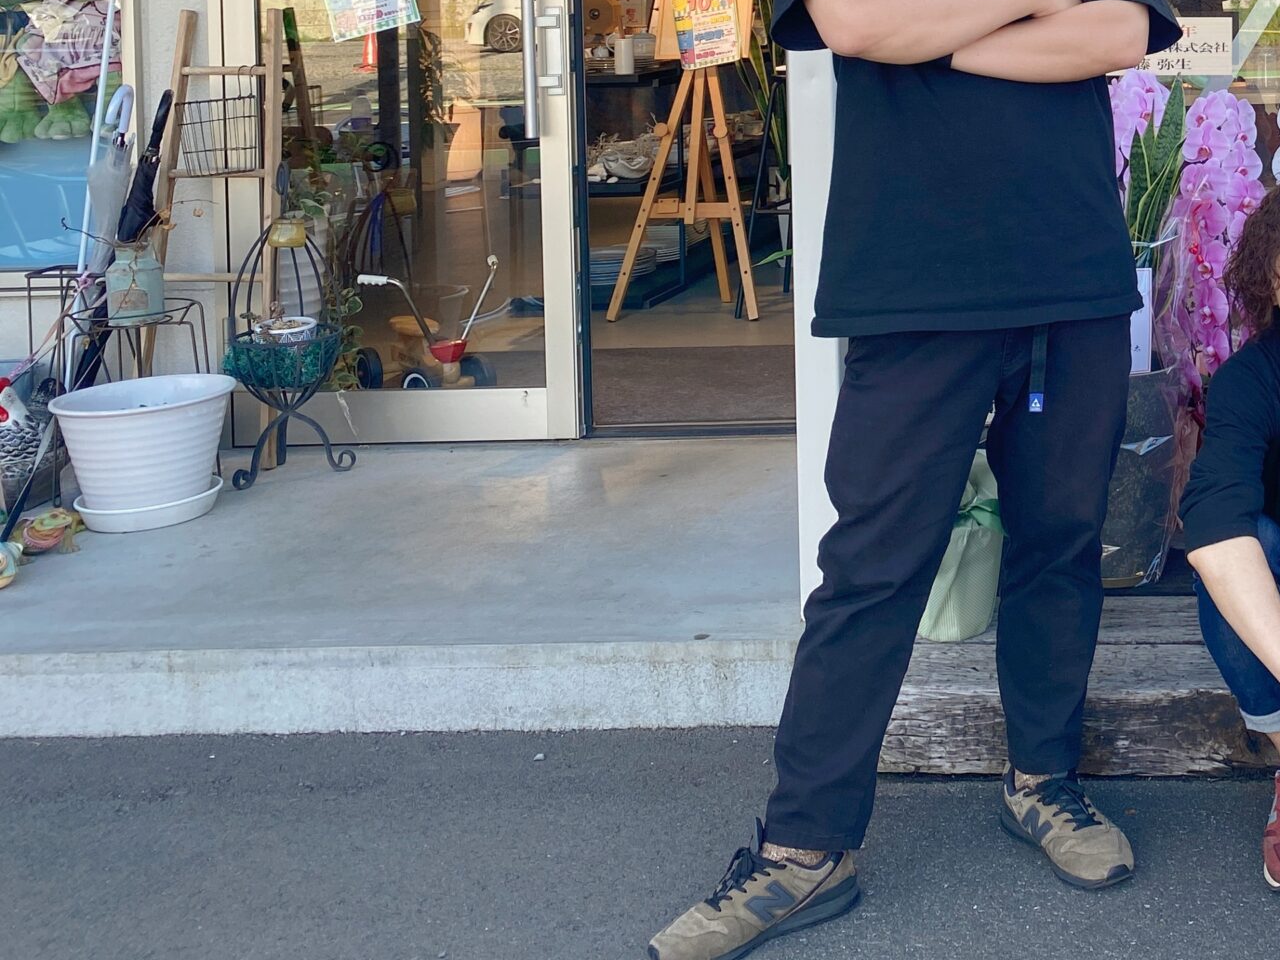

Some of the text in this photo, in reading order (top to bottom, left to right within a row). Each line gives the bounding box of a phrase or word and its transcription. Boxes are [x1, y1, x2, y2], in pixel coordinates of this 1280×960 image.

[1163, 42, 1230, 54] 株式会社
[1157, 58, 1192, 71] 弥生
